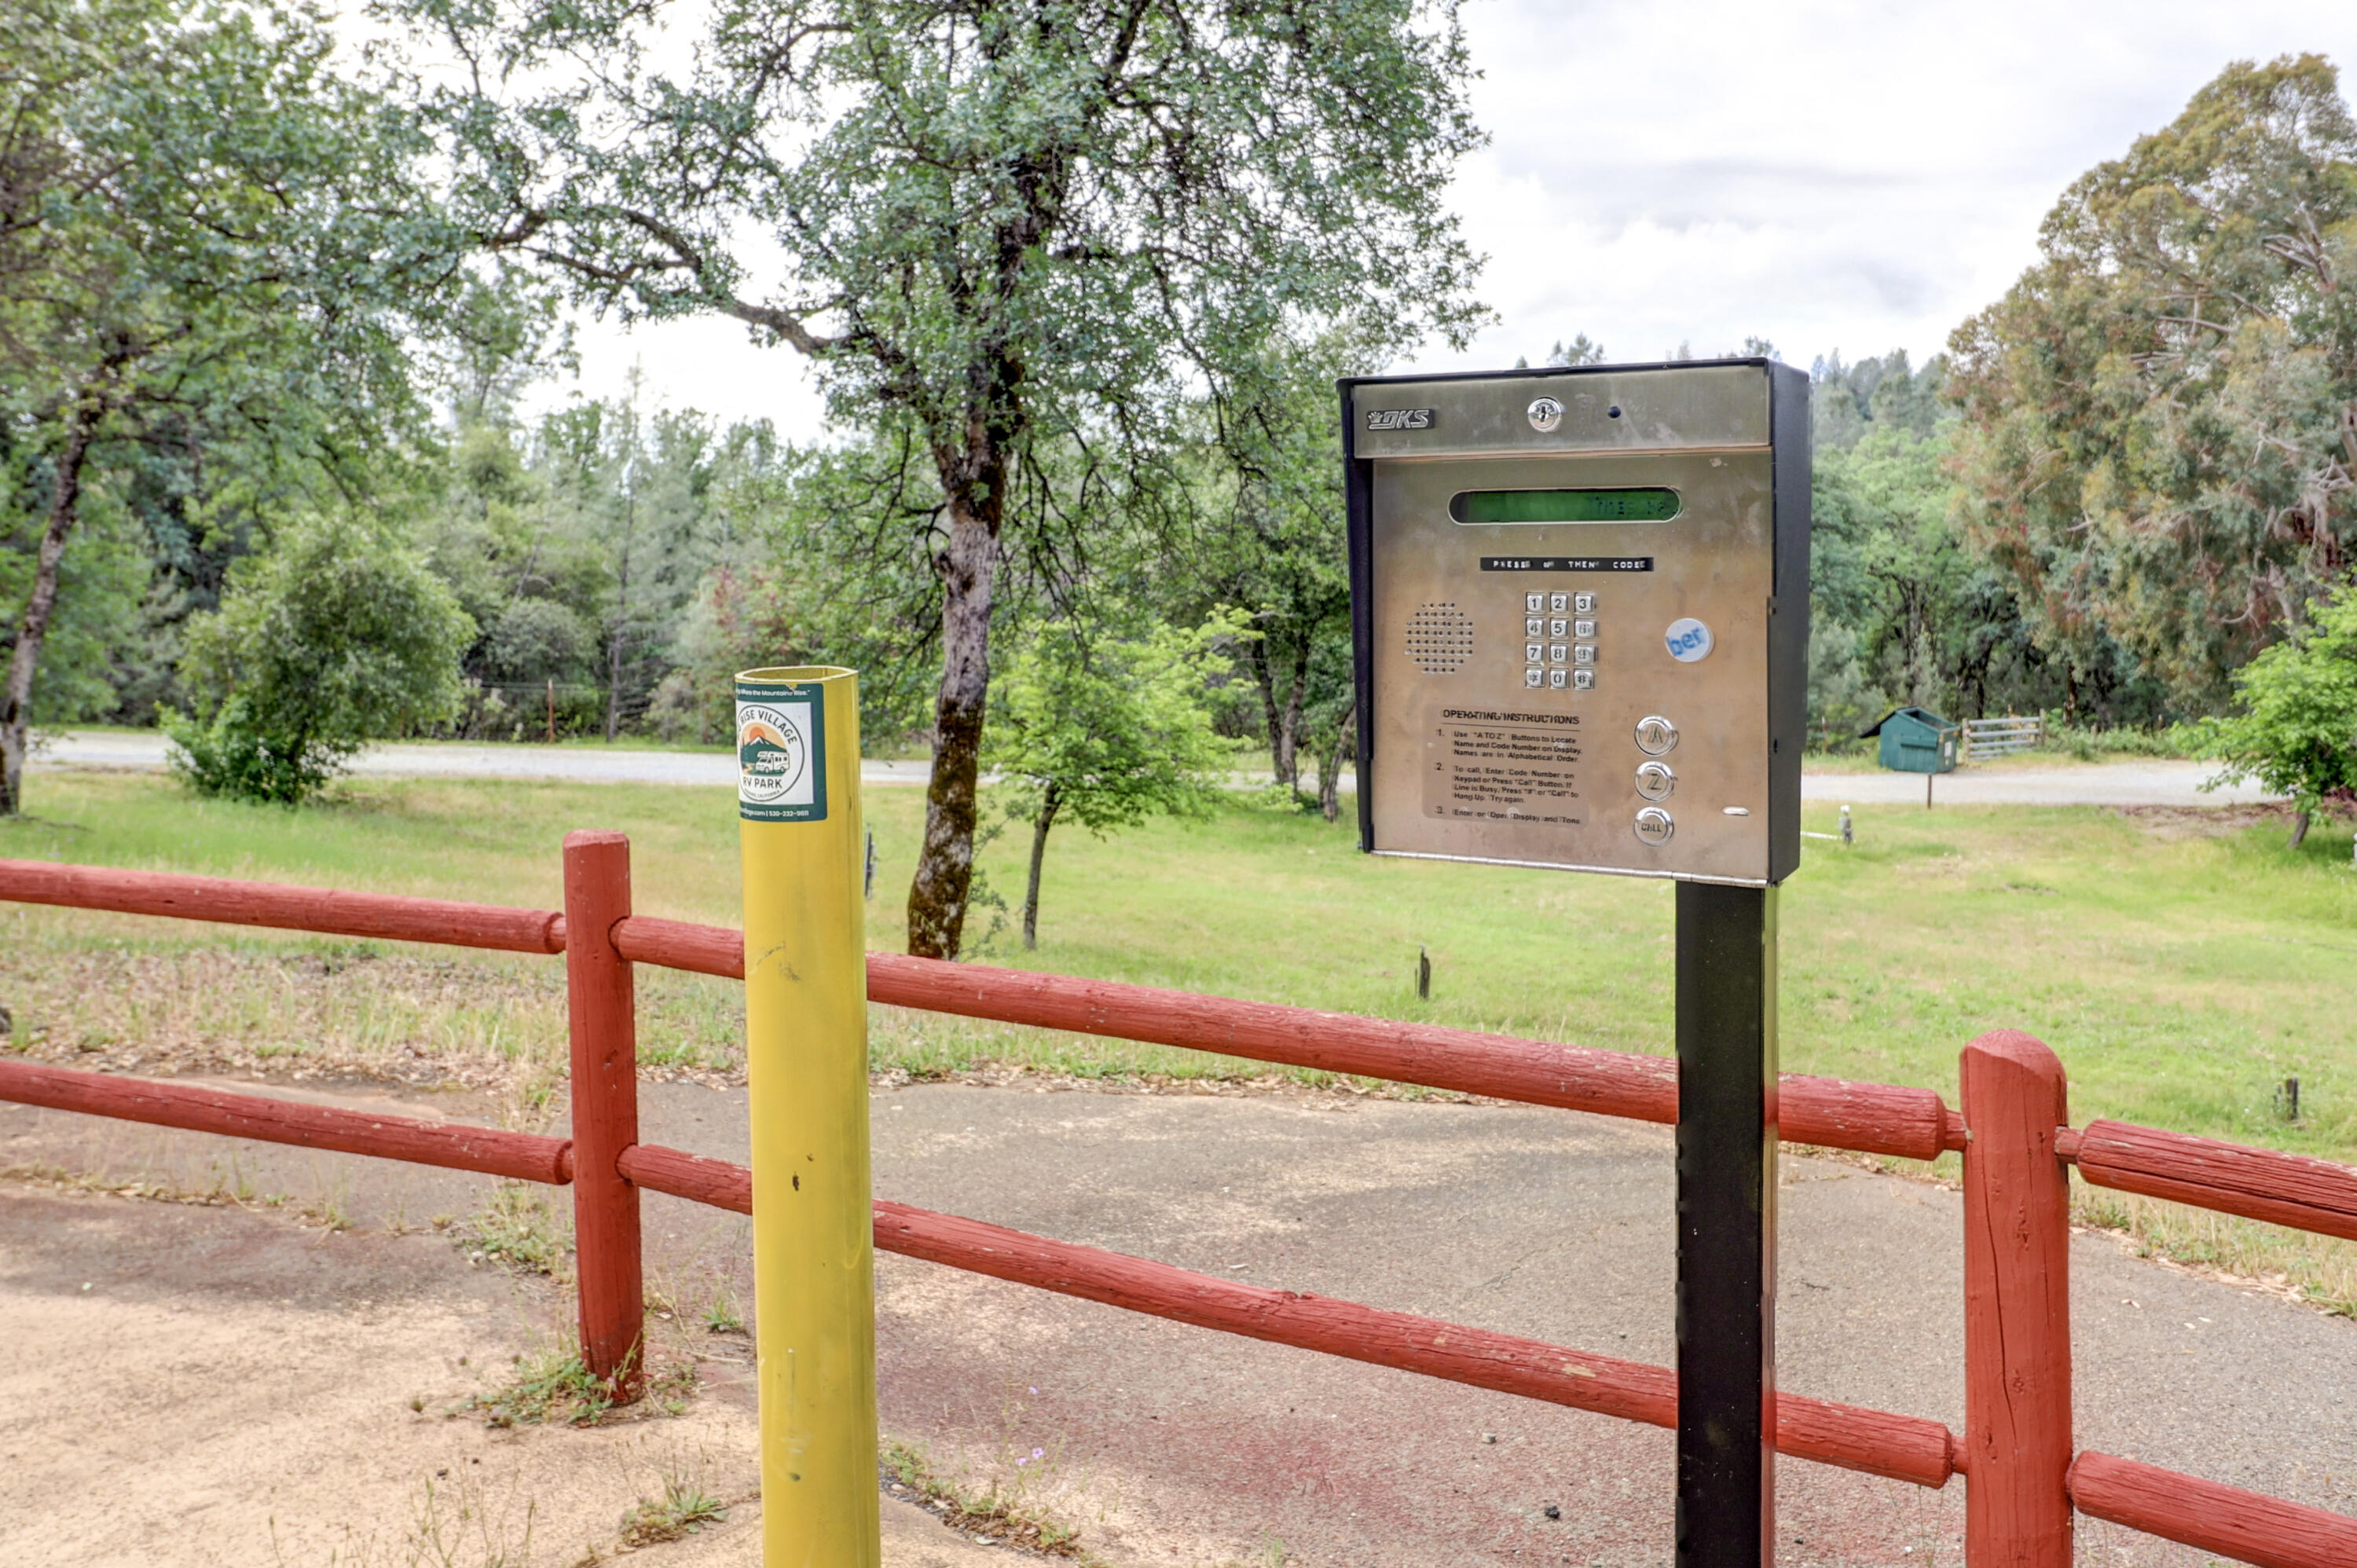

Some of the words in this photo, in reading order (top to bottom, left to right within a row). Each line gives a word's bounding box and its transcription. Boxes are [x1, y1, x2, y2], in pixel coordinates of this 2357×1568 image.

[1369, 409, 1429, 430] DKS
[1531, 598, 1537, 609] 1
[1554, 599, 1562, 609] 2
[1578, 599, 1587, 609] 3
[1530, 623, 1538, 633] 4
[1554, 623, 1563, 634] 5
[1578, 624, 1590, 635] 6
[1530, 647, 1538, 658] 7
[1554, 649, 1562, 659] 8
[1578, 649, 1587, 660] 9
[1553, 673, 1562, 684] 0
[1442, 709, 1501, 720] OPERATING
[1503, 713, 1580, 724] INSTRUCTIONS
[740, 709, 755, 724] RISE
[758, 709, 797, 745] VILLAGE
[1435, 728, 1445, 737] 1.
[1649, 727, 1663, 743] A
[1508, 752, 1553, 761] Alphabetical
[1436, 762, 1444, 771] 2.
[1531, 770, 1560, 779] Number
[742, 776, 752, 786] RV
[754, 779, 783, 789] PARK
[1453, 775, 1481, 783] Keypad
[1648, 773, 1662, 790] Z
[1453, 793, 1474, 801] Hang
[1490, 794, 1503, 803] Try
[1513, 814, 1540, 822] Display
[1641, 823, 1662, 832] CALL
